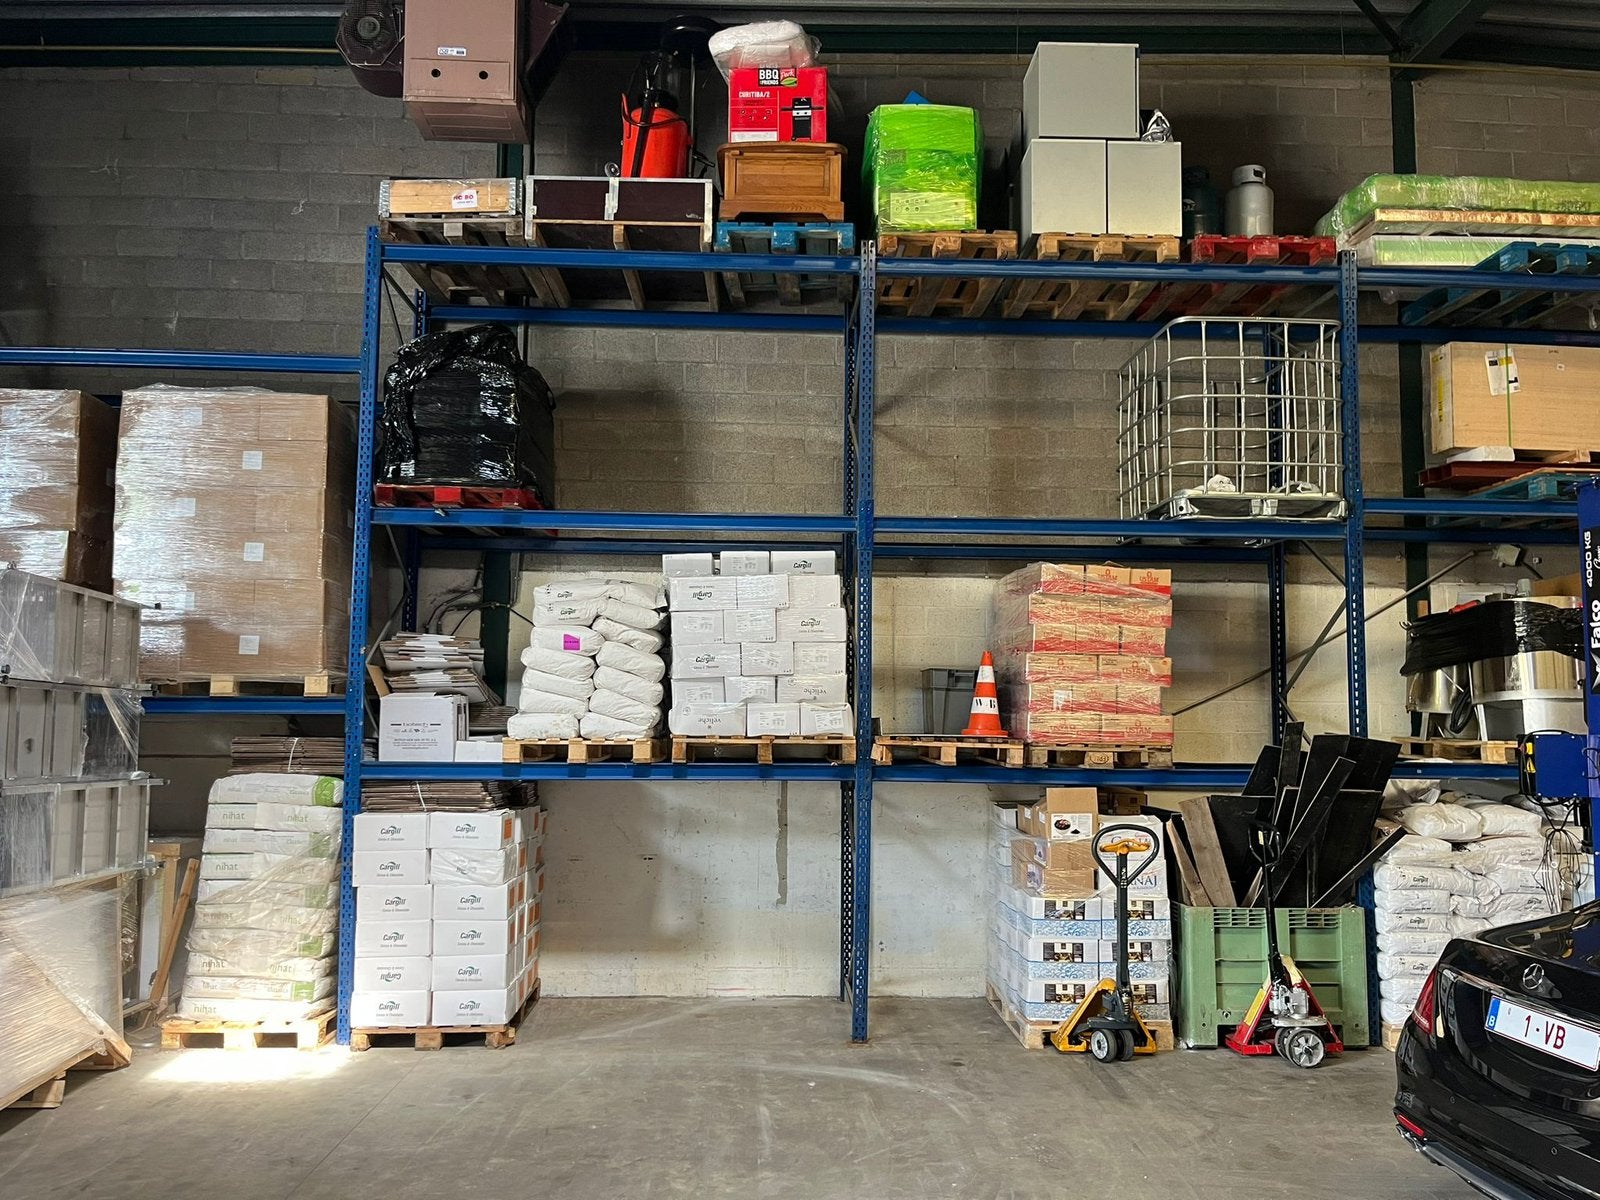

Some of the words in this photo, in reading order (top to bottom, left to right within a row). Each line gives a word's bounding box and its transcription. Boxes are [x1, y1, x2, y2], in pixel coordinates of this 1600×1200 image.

[760, 70, 779, 80] BBQ
[1584, 531, 1591, 549] KG
[793, 561, 812, 569] Cargill
[693, 591, 712, 600] Cargill
[800, 618, 821, 627] Cargill
[1590, 600, 1600, 648] Falco
[288, 814, 308, 822] nihat
[381, 826, 401, 836] Cargill
[456, 824, 476, 834] Cargill
[215, 863, 238, 871] nihat
[380, 862, 400, 872] Cargill
[385, 897, 406, 907] Cargill
[460, 895, 481, 905] Cargill
[383, 932, 404, 942] Cargill
[460, 930, 481, 940] Cargill
[202, 960, 225, 968] nihat
[458, 966, 479, 976] Cargill
[381, 973, 401, 982] Cargill
[194, 1005, 216, 1014] nihat
[379, 1001, 400, 1011] Cargill
[459, 1001, 480, 1011] Cargill
[1489, 1016, 1495, 1026] B
